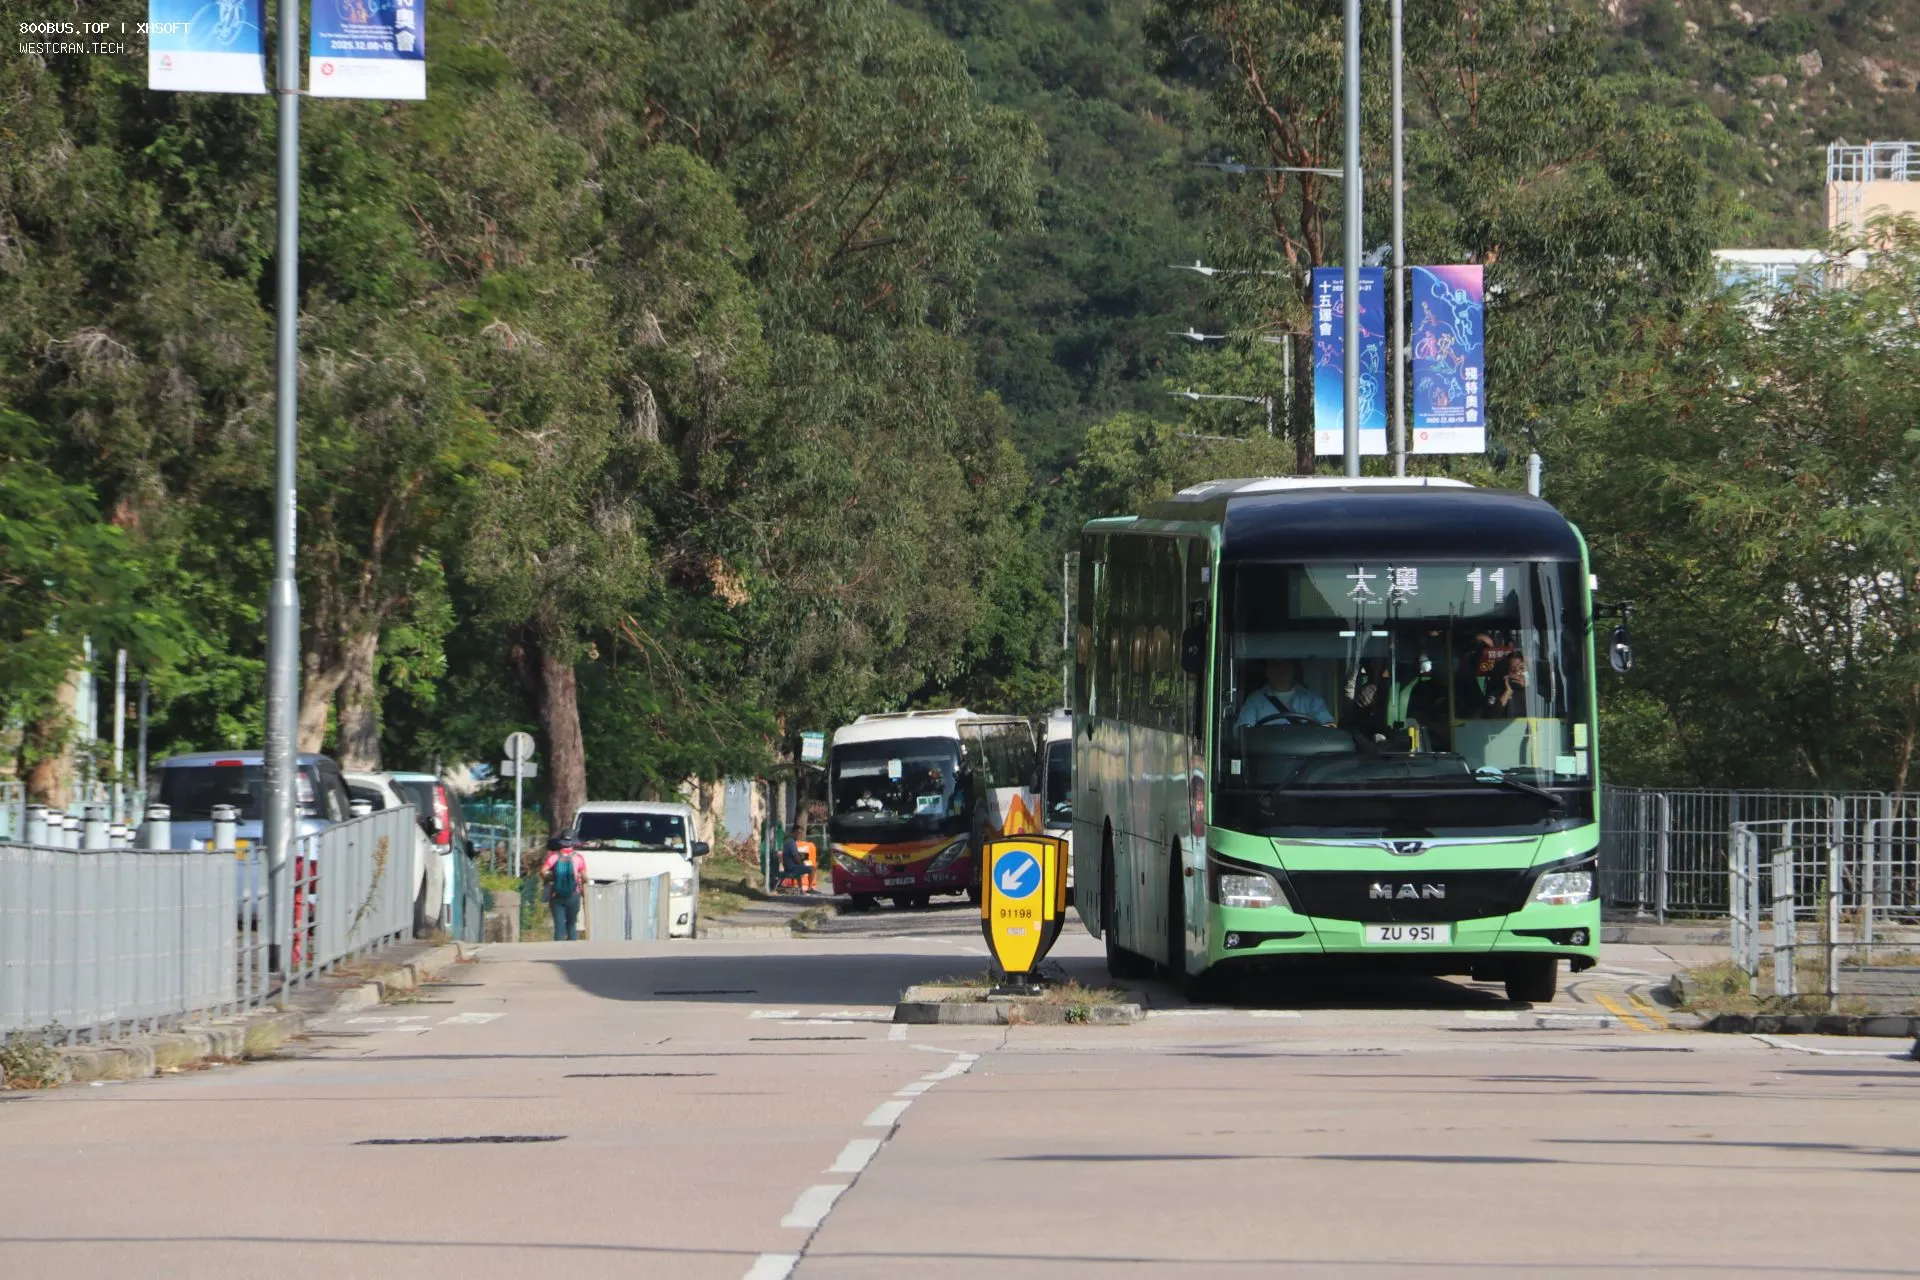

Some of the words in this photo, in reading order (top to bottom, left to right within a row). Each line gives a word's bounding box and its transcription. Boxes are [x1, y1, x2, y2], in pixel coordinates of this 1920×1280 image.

[1346, 567, 1419, 597] 大澳
[1466, 567, 1505, 604] 11
[1369, 883, 1445, 899] MAN
[1000, 908, 1032, 918] 91198
[1381, 927, 1402, 940] ZU
[1409, 927, 1435, 940] 951
